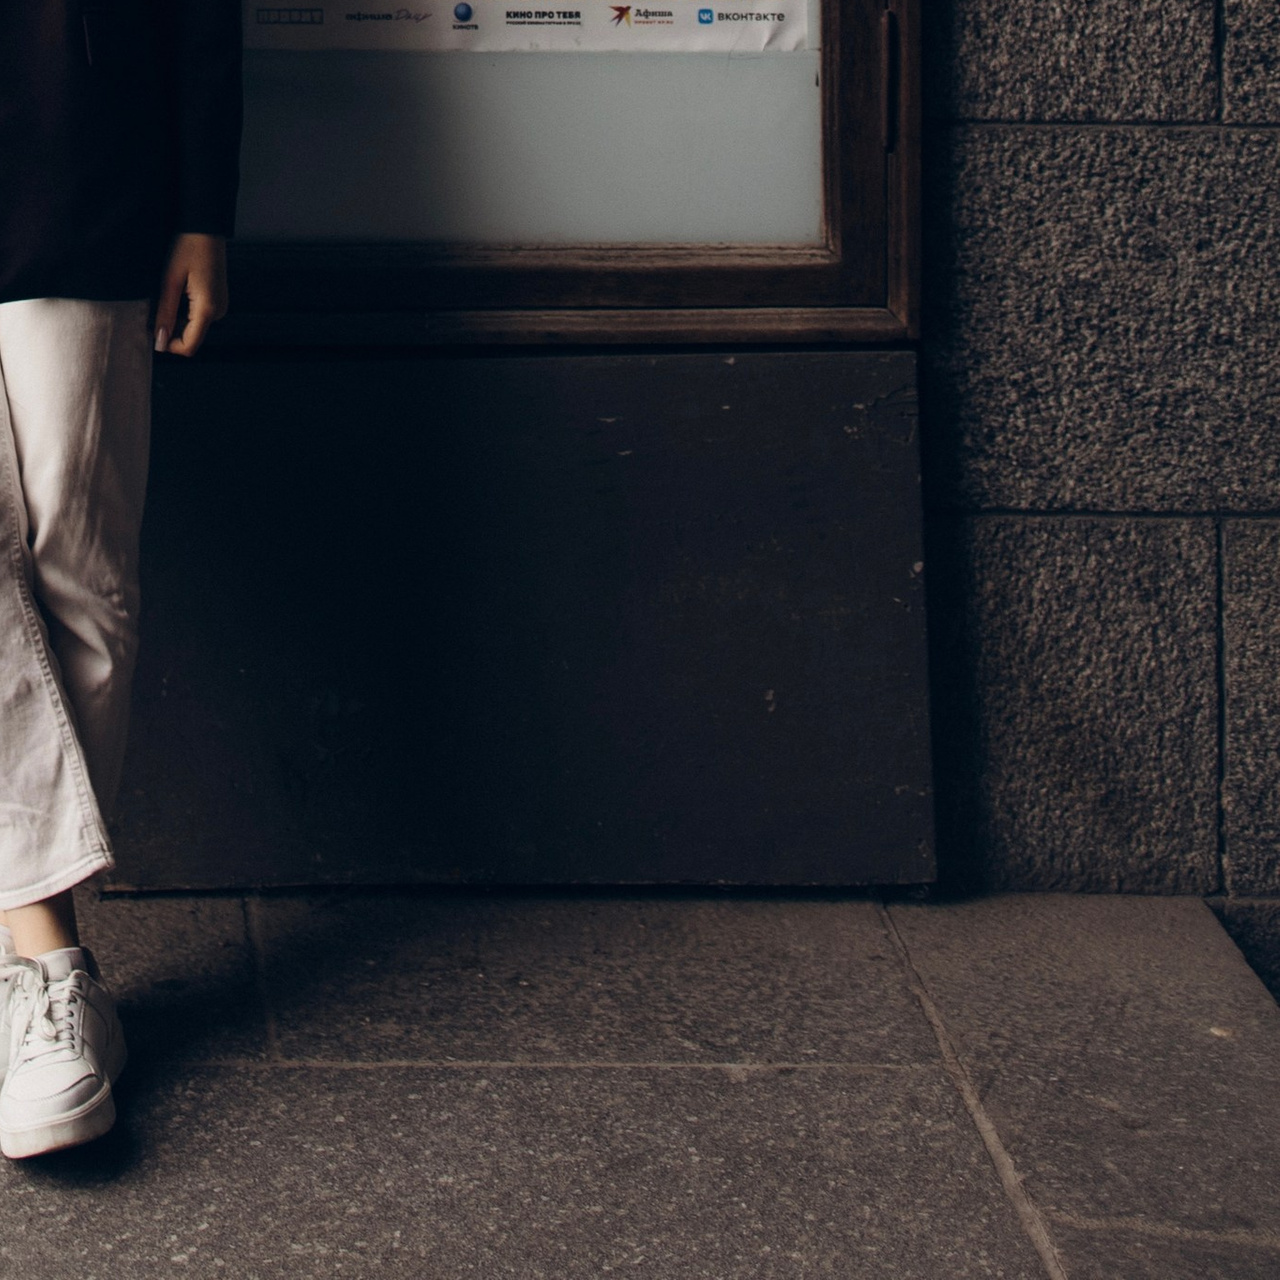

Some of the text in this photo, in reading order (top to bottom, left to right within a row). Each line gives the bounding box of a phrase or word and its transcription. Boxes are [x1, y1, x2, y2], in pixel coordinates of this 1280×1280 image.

[506, 11, 581, 19] КИНО ПРО ТЕБЯ
[717, 12, 785, 22] вконтакте
